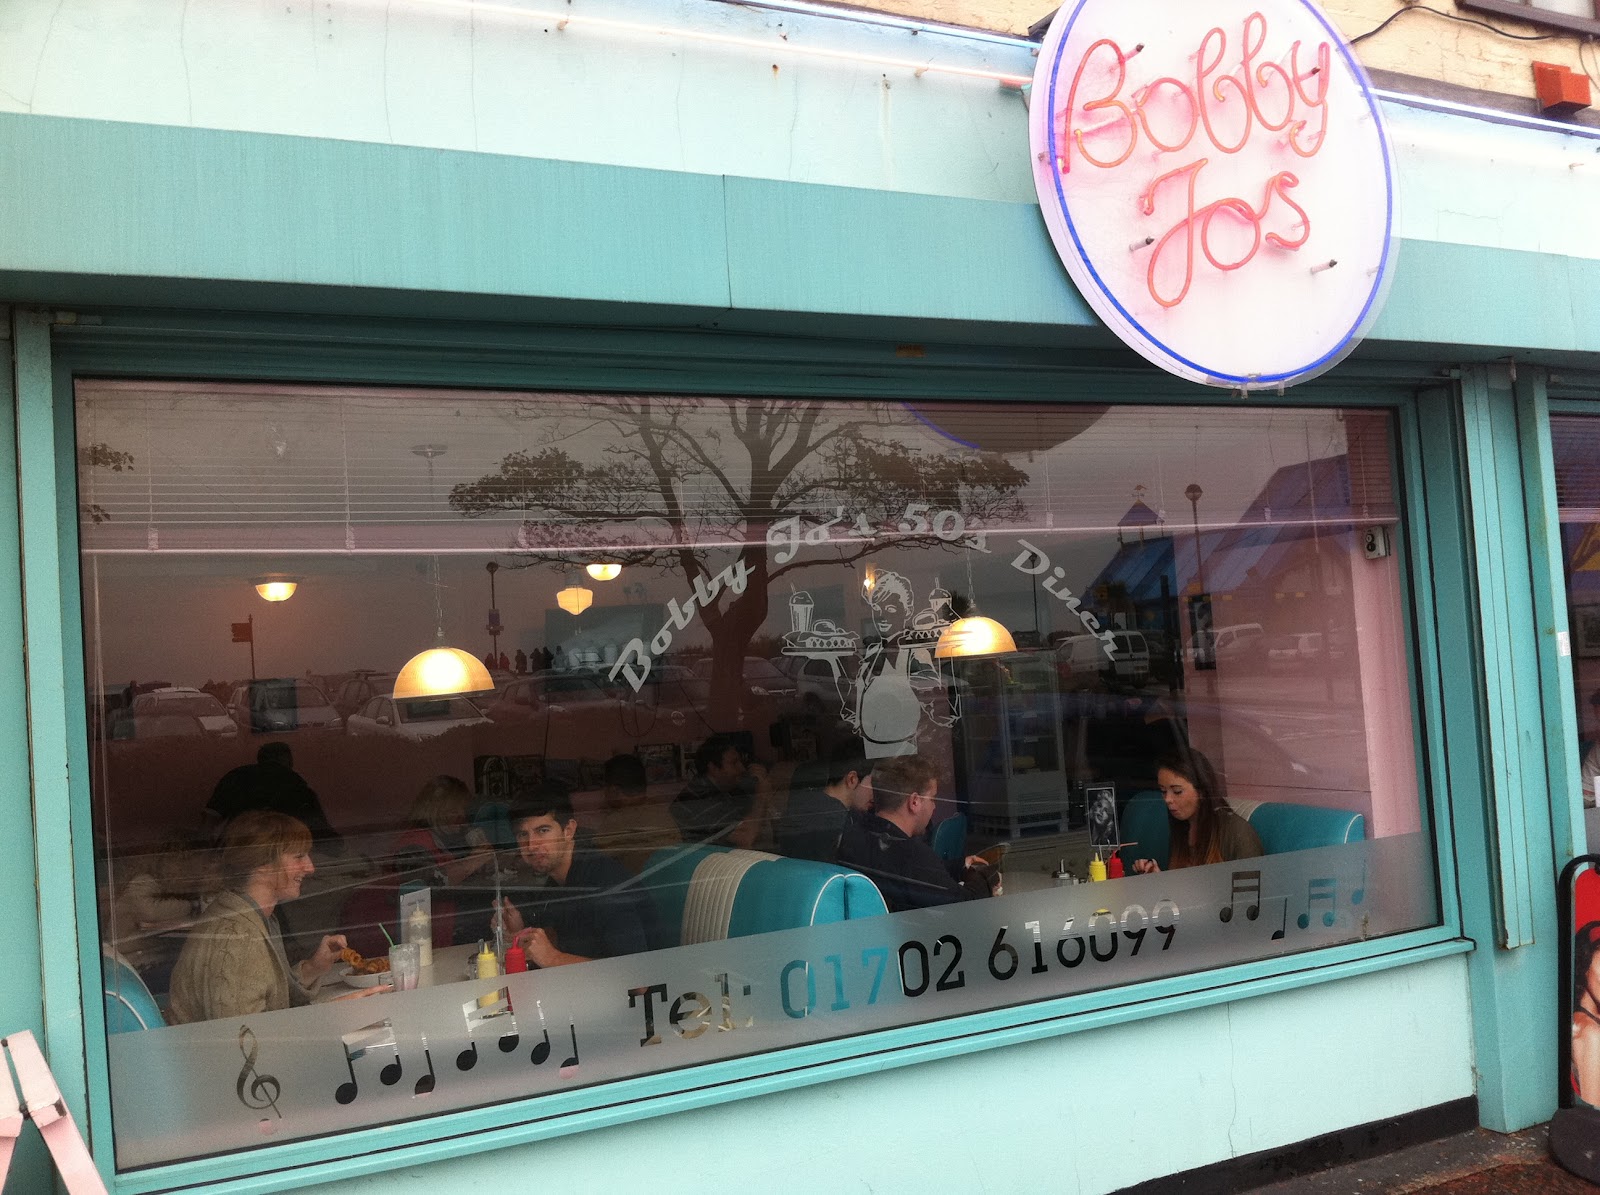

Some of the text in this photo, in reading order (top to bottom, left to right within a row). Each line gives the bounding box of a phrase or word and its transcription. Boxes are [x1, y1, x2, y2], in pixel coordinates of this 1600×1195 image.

[1062, 11, 1329, 173] Bobby
[608, 556, 755, 692] Bobby
[766, 505, 877, 564] Jo's
[1010, 538, 1121, 661] Diner
[780, 934, 964, 1019] 01702
[988, 899, 1180, 981] 616099
